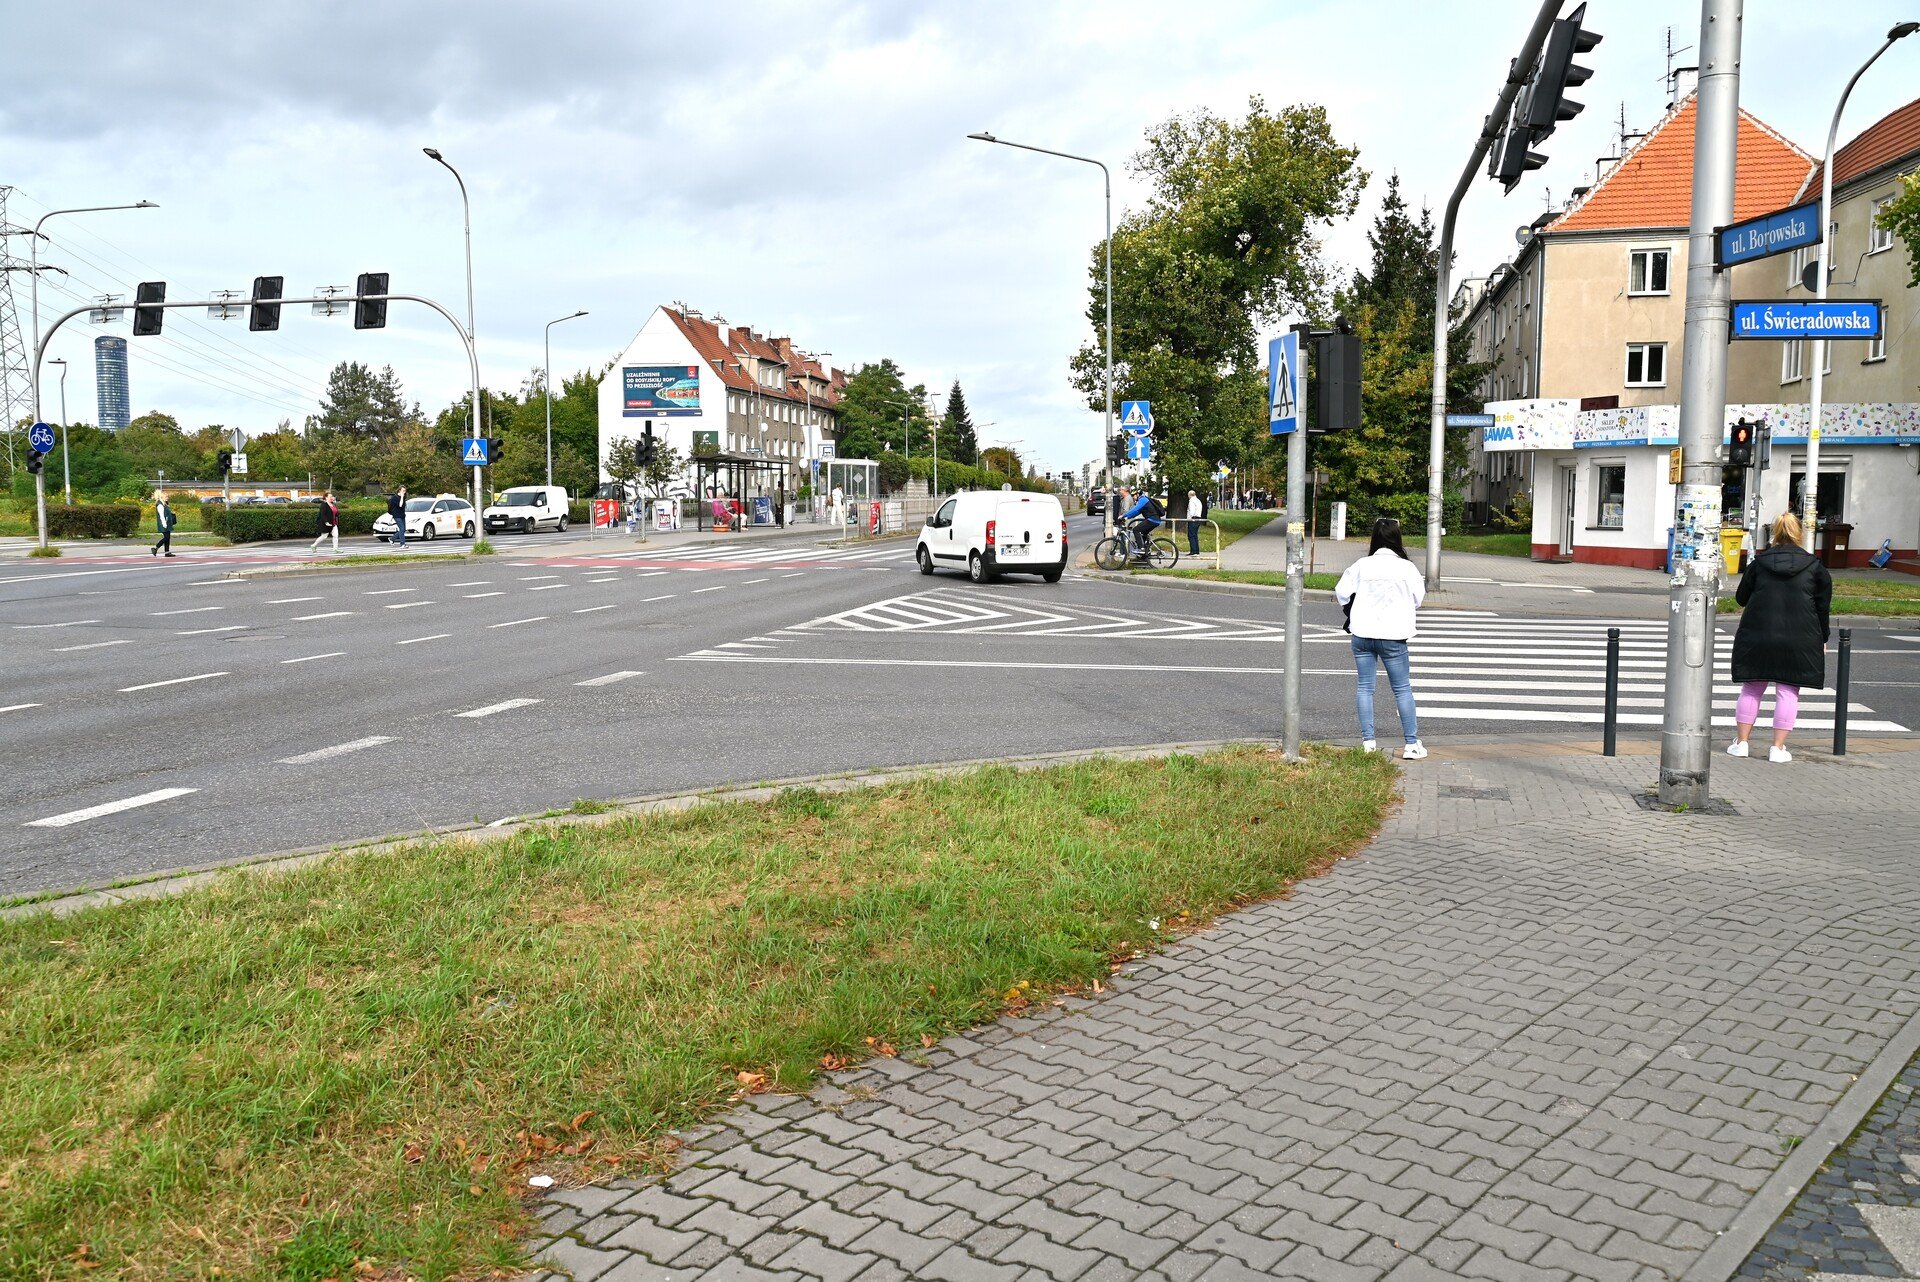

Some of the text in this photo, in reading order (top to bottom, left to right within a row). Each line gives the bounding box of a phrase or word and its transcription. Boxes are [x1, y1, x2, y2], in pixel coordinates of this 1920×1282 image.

[1731, 218, 1806, 255] ul. Borowska
[1741, 306, 1871, 330] ul. Świeradowska
[1502, 412, 1515, 423] się
